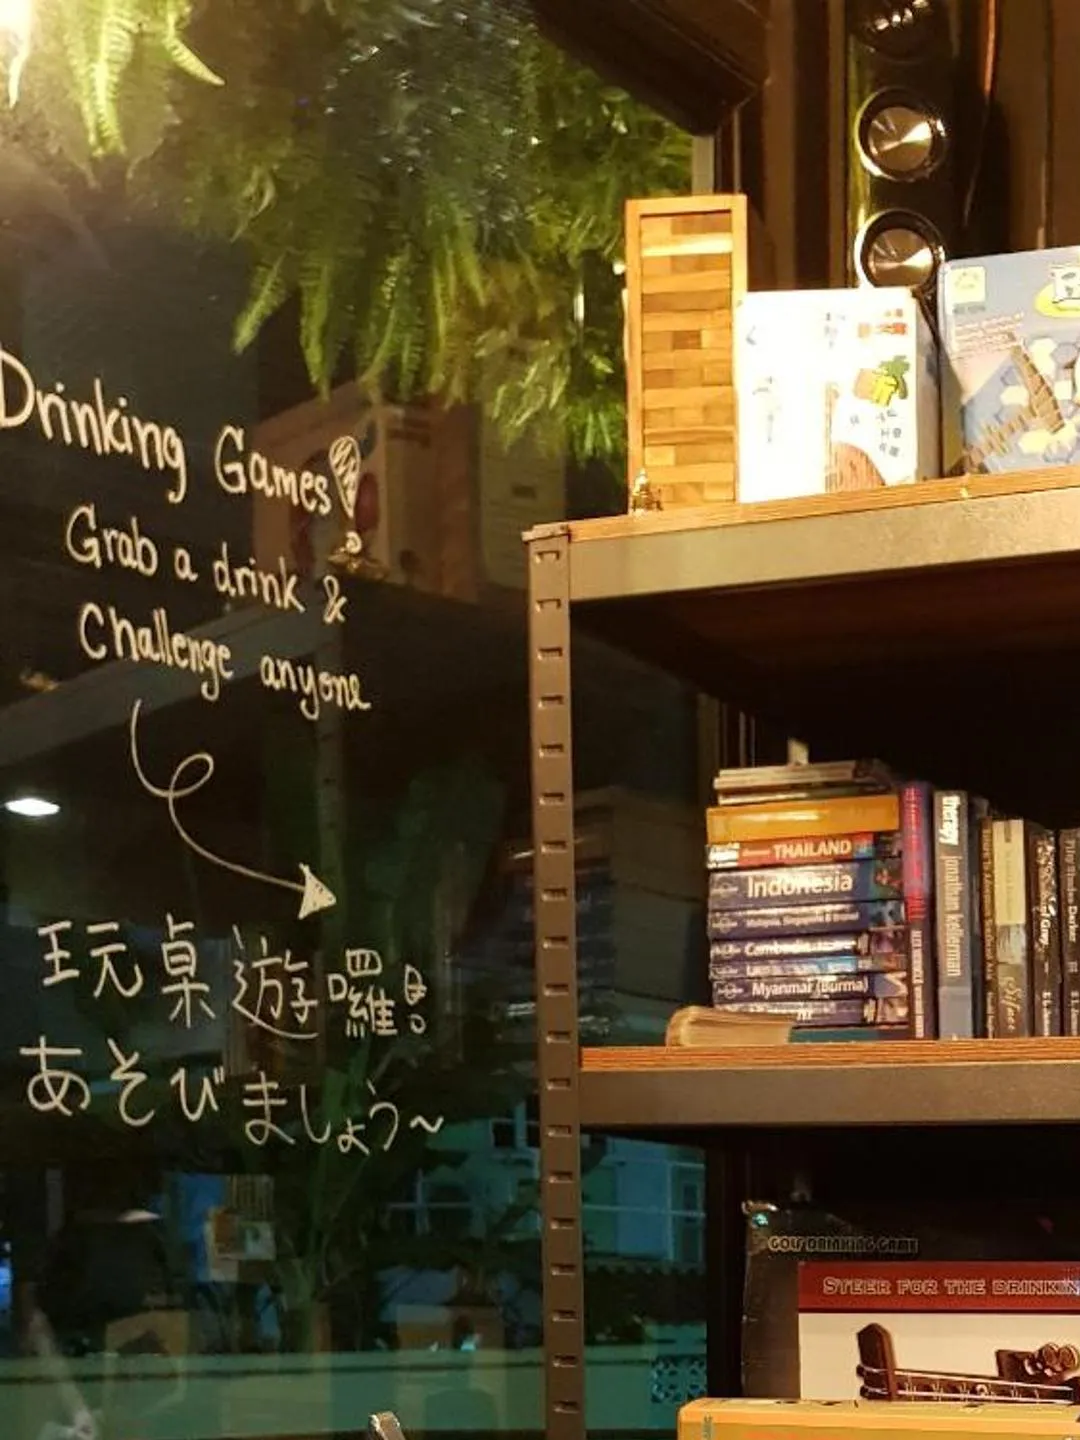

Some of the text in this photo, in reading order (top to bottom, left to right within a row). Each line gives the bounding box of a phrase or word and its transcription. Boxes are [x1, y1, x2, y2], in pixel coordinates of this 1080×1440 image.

[0, 348, 187, 504] Drinking
[66, 504, 348, 625] Grab a drink &
[78, 601, 372, 721] Challenge anyone
[773, 839, 852, 861] THAILAND
[748, 871, 854, 899] Indonesia
[939, 794, 965, 978] therapy jonathan kellerman
[1068, 905, 1079, 942] Darker
[751, 978, 870, 1000] Myanmar (Burma)
[767, 1234, 802, 1253] GOLF
[822, 1276, 892, 1295] STEER
[896, 1279, 938, 1295] FOR
[943, 1278, 987, 1295] THE
